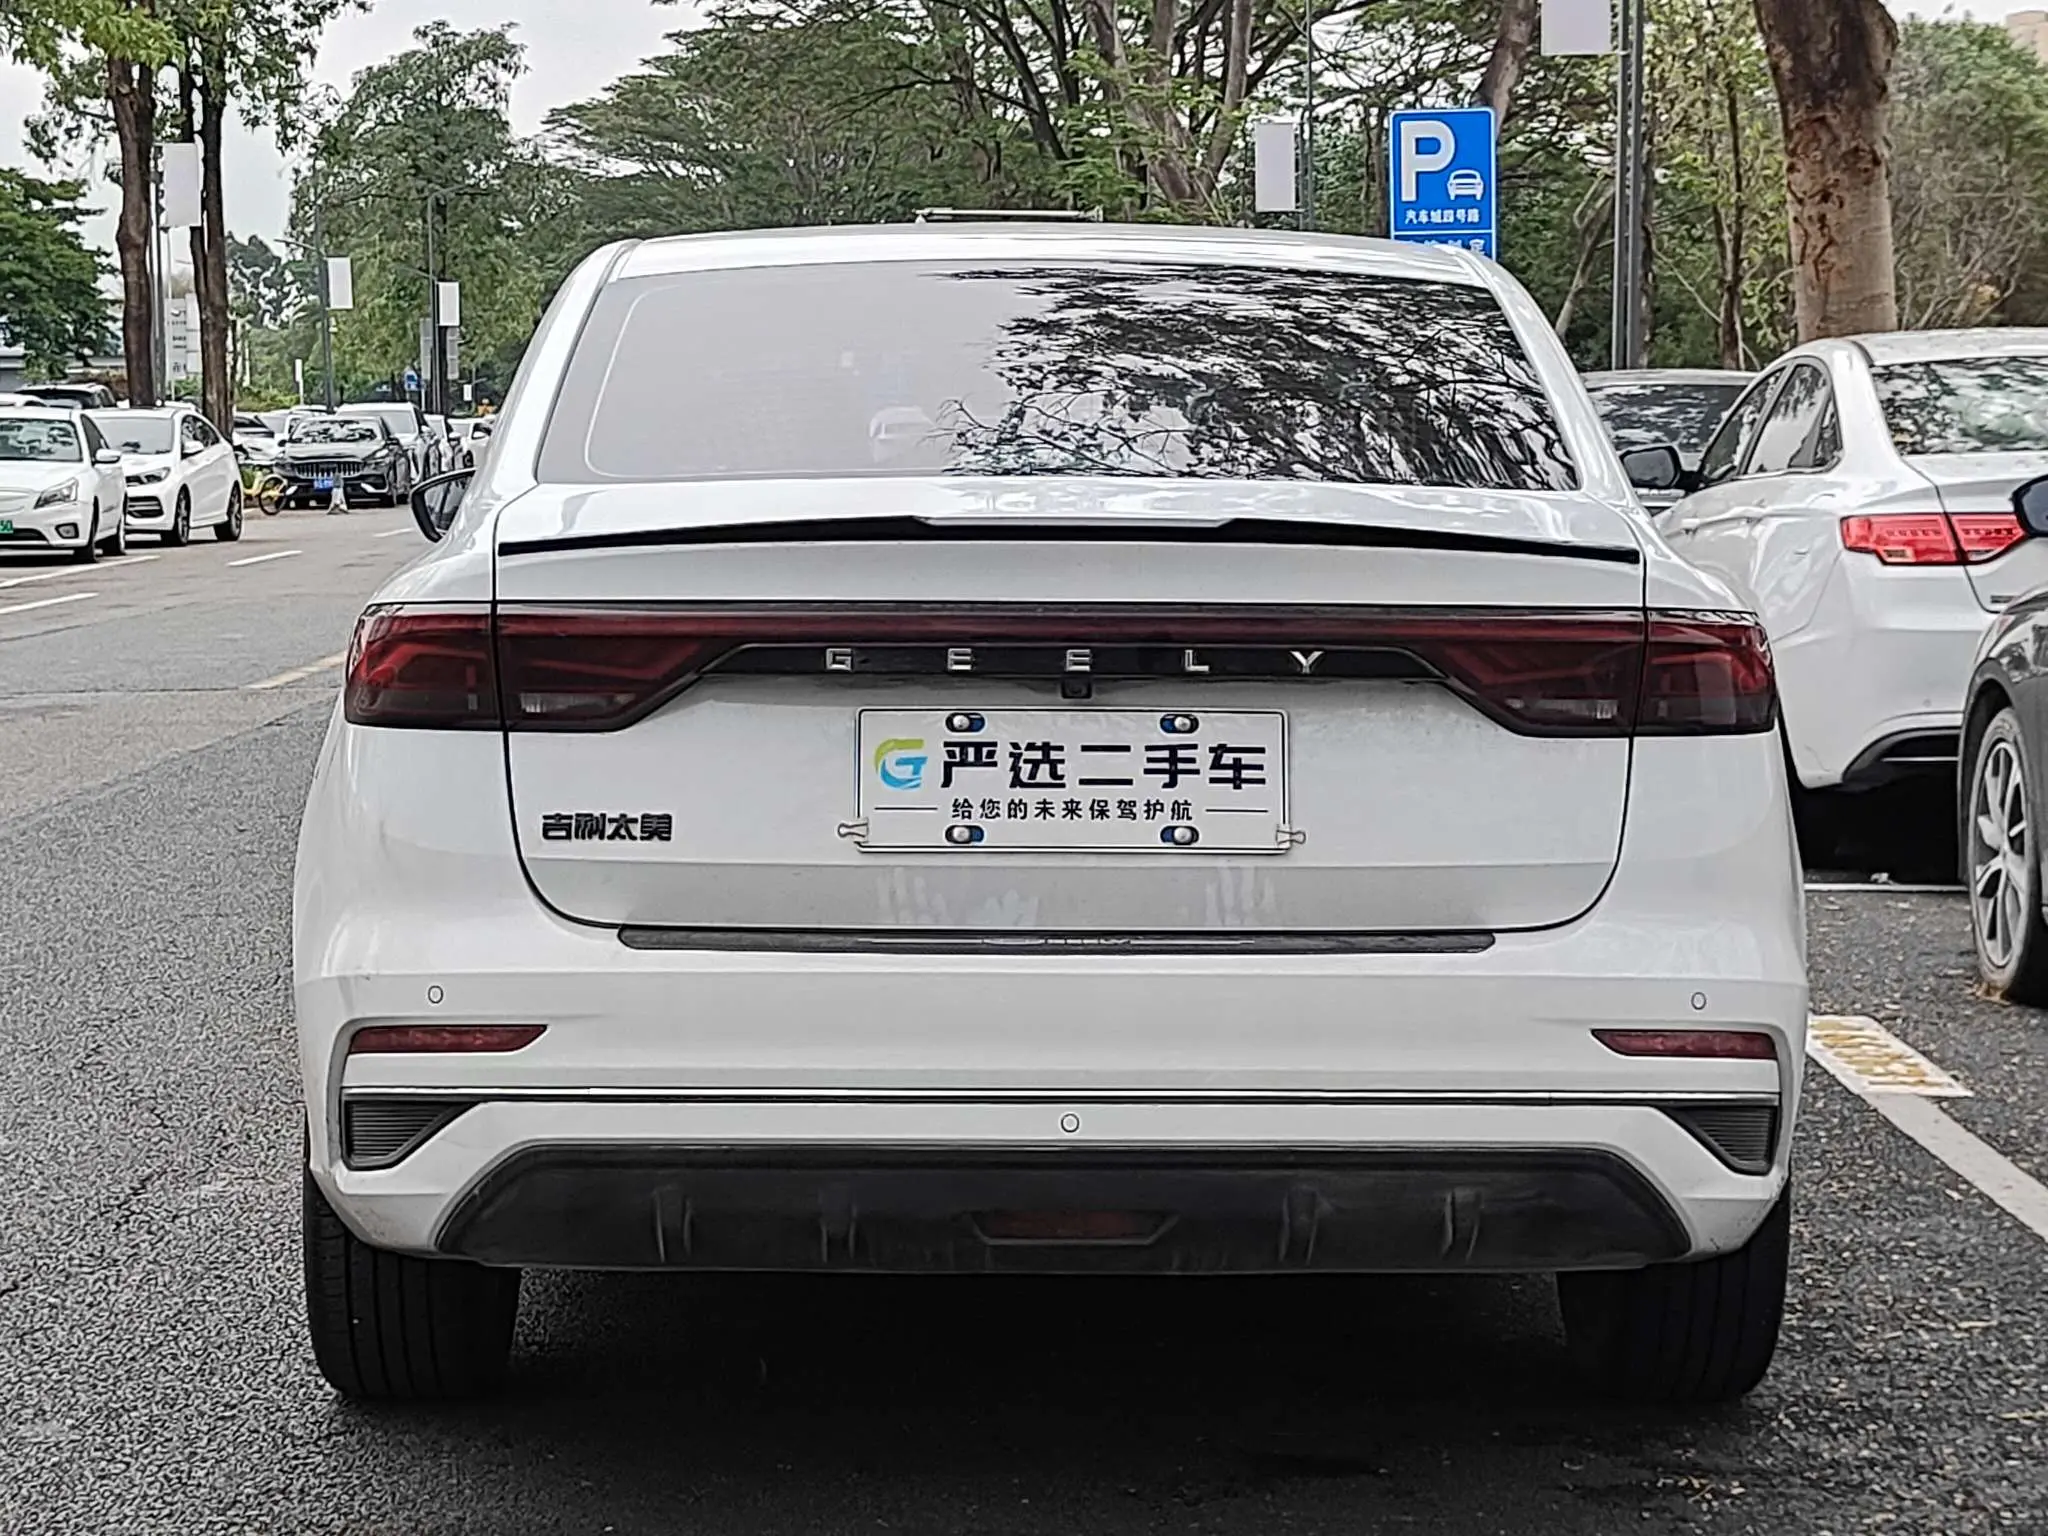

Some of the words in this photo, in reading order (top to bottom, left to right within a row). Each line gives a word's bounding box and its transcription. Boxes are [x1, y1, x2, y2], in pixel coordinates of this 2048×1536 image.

[1401, 120, 1455, 201] P
[825, 648, 1324, 672] GEELY
[940, 740, 1266, 790] 严选二手车
[951, 798, 1193, 822] 给您的未来保驾护航
